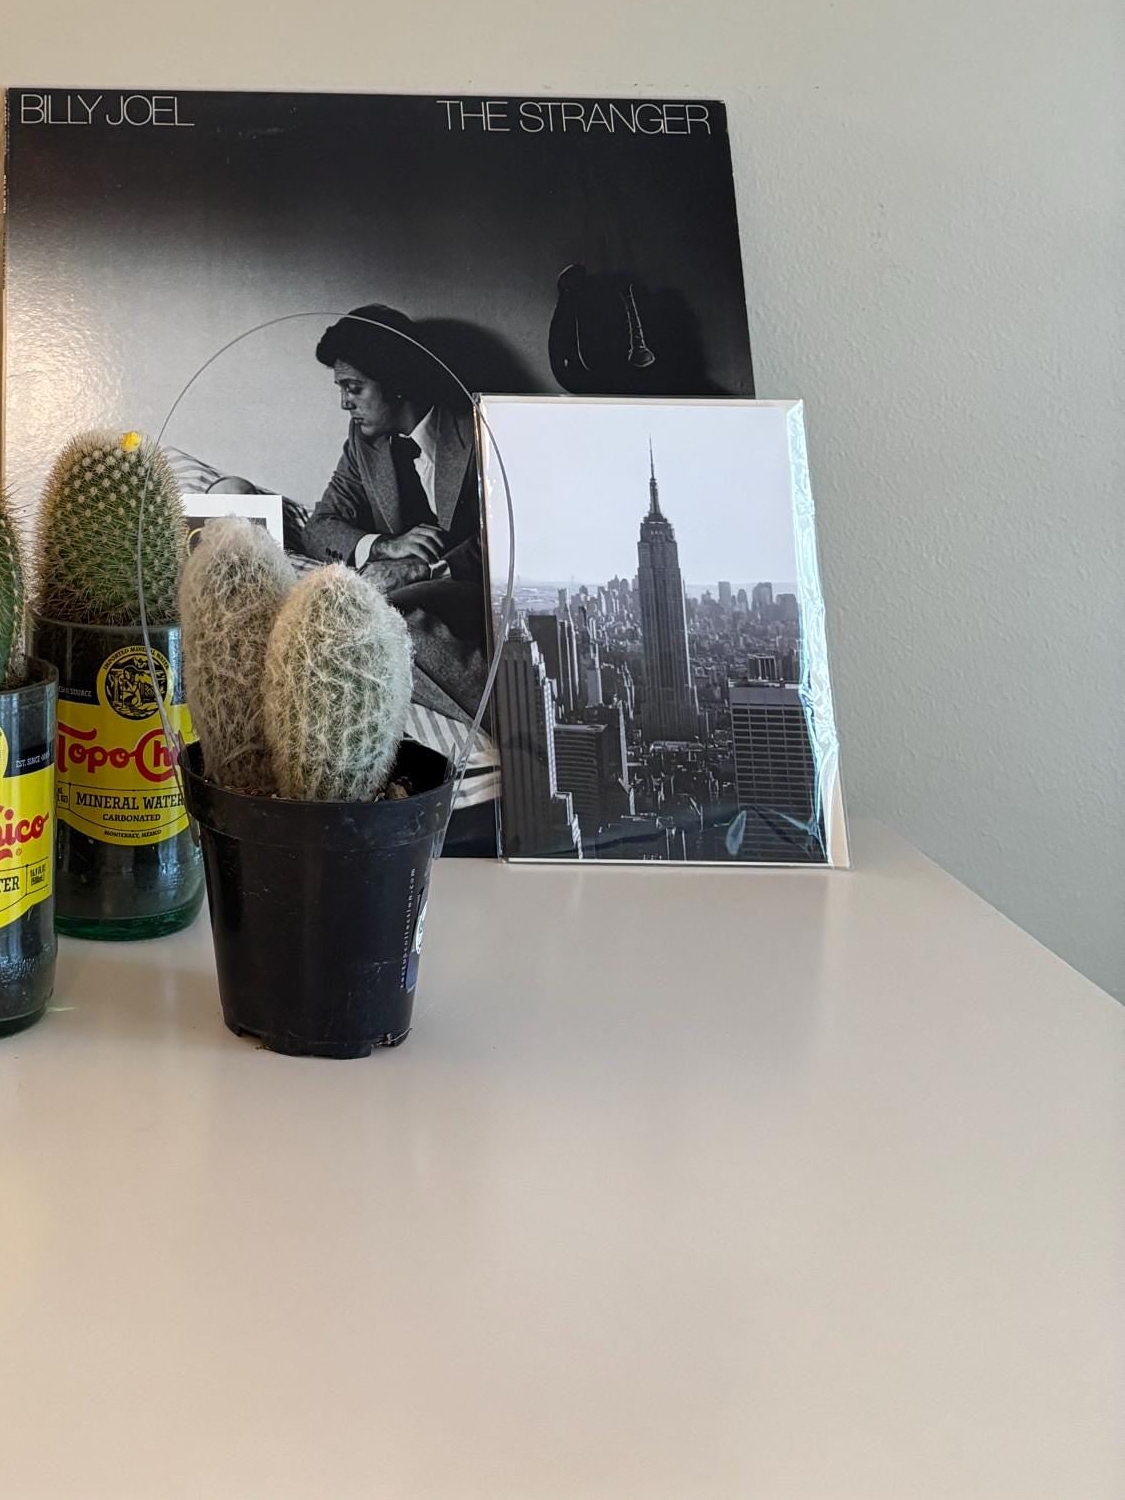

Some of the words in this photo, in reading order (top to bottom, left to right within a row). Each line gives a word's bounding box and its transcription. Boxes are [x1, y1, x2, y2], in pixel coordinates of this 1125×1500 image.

[20, 93, 103, 125] BILLY
[105, 94, 196, 126] JOEL
[436, 100, 511, 132] THE
[519, 101, 711, 135] STRANGER
[58, 721, 130, 774] Topo
[75, 791, 139, 810] MINERAL
[102, 813, 161, 822] CARBONATED
